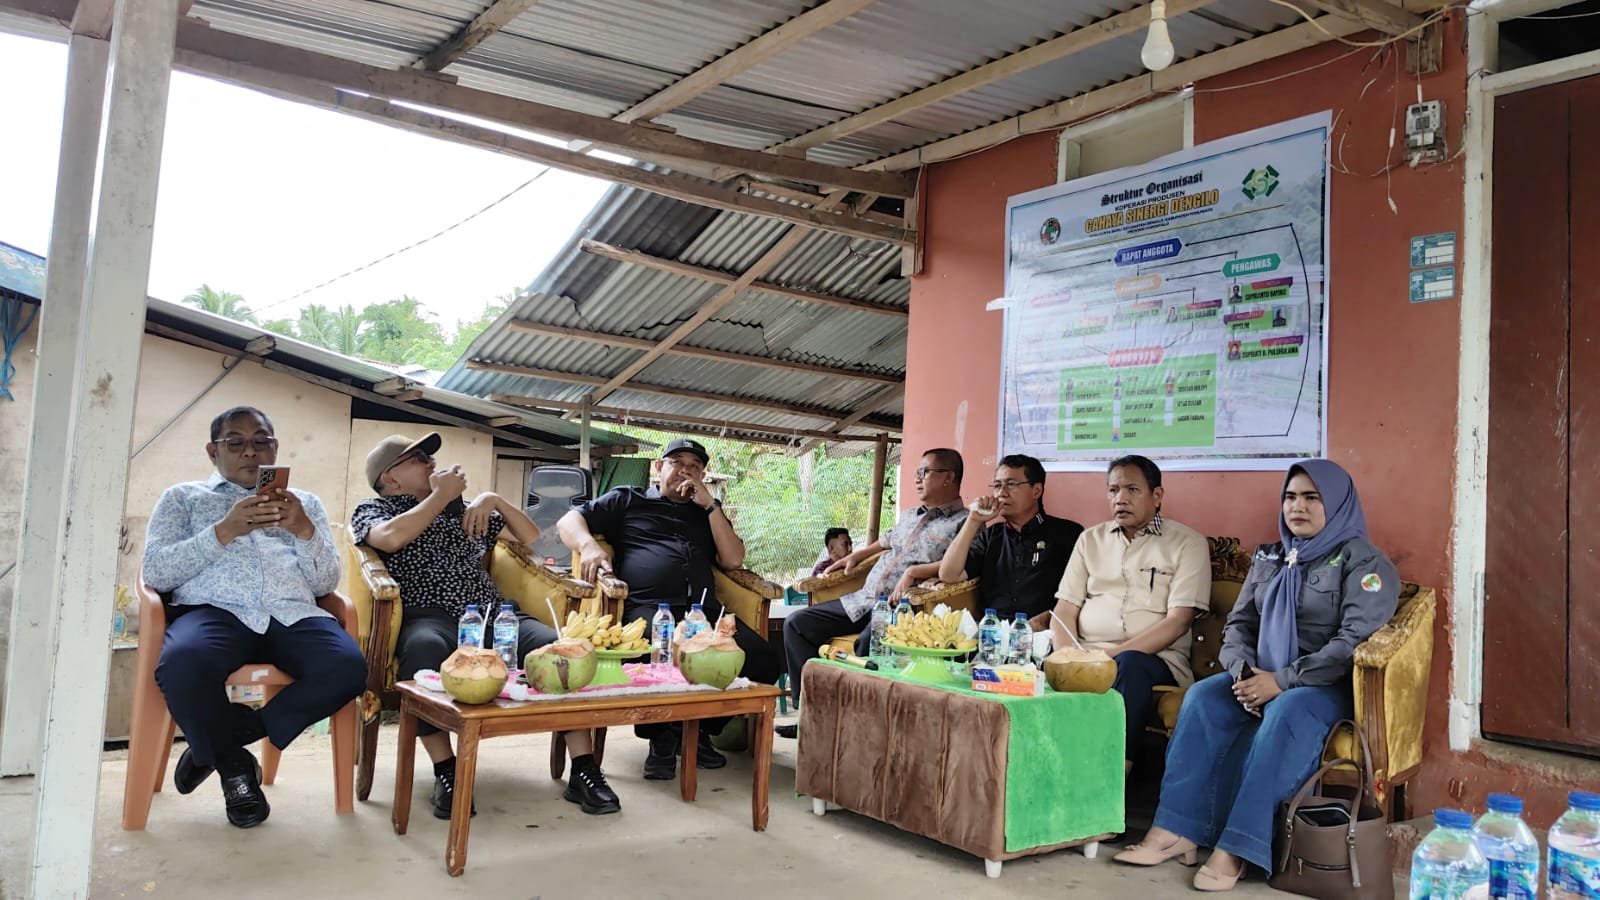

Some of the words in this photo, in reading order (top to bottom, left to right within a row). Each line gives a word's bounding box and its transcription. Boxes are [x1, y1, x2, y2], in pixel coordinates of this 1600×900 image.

[1101, 187, 1144, 206] Struktur
[1146, 172, 1203, 195] Organisasi
[1085, 212, 1123, 233] CAHAYA
[1125, 200, 1169, 224] SINERGI
[1171, 188, 1220, 213] DENGILO
[1115, 199, 1147, 211] KOPERASI
[1148, 190, 1185, 204] PRODUSEN
[1121, 248, 1142, 262] RAPAT
[1142, 244, 1174, 259] ANGGOTA
[1231, 258, 1272, 273] PENGAWAS
